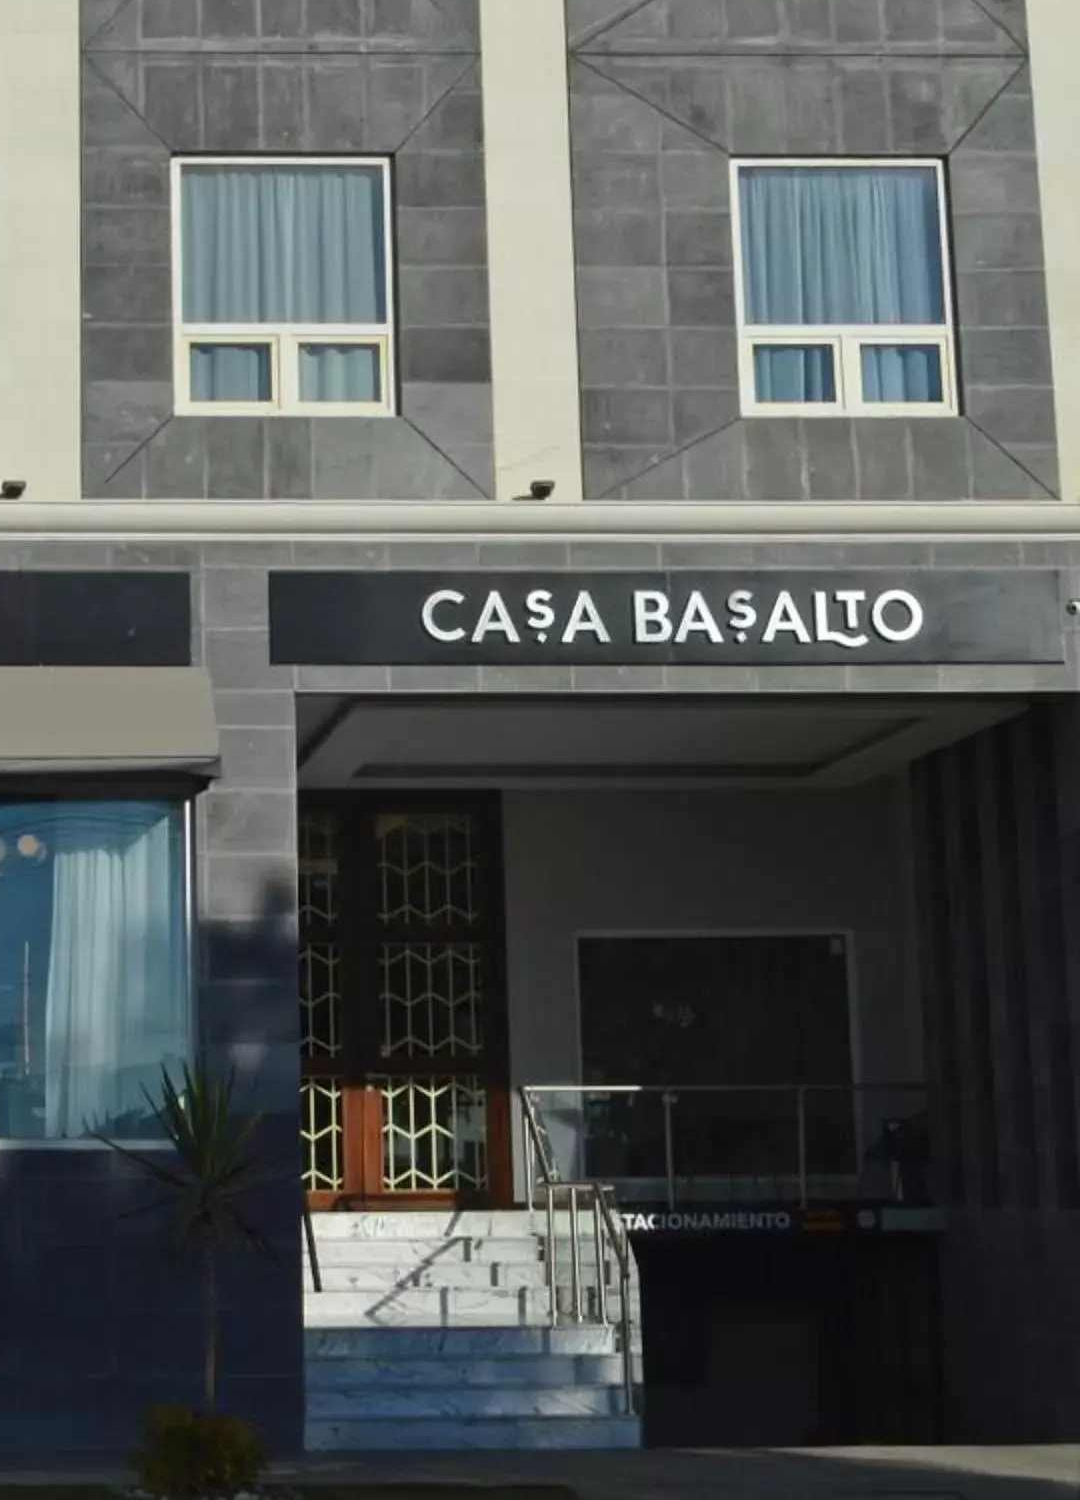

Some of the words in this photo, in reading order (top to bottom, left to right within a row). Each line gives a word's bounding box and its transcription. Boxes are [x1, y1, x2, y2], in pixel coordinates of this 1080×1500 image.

[421, 589, 612, 644] CASA
[634, 588, 926, 647] BASALTO
[617, 1211, 790, 1230] TACIONAMIENTO
